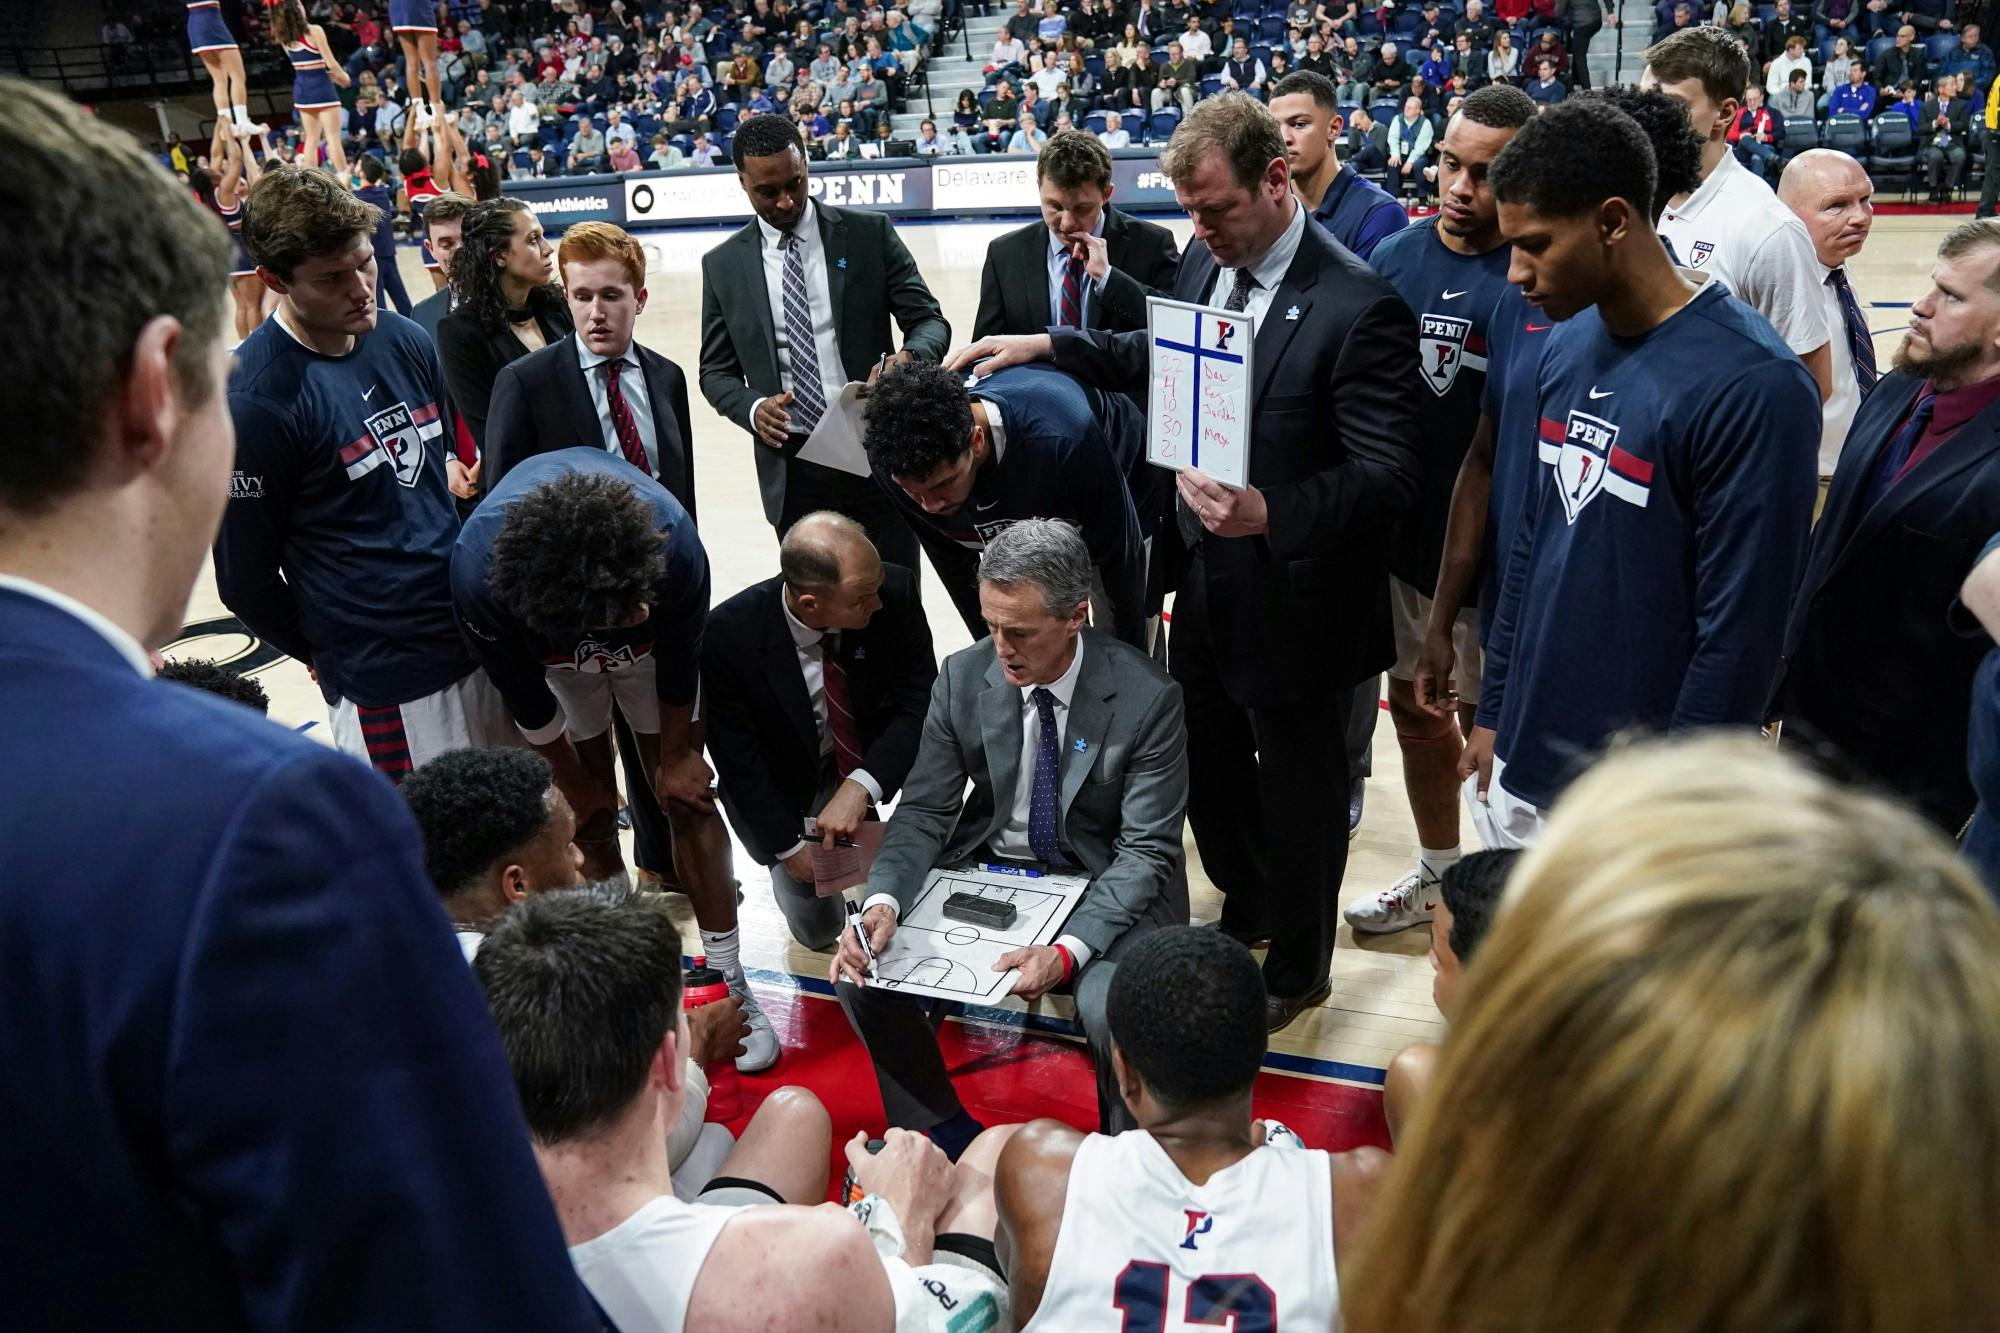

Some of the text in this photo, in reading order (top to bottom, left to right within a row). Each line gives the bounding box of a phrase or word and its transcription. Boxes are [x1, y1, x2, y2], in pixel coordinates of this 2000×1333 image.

[938, 168, 1028, 188] Delaware
[1216, 320, 1235, 350] P
[1423, 320, 1464, 339] PENN
[1433, 344, 1456, 378] P
[1164, 374, 1176, 398] 4
[1162, 414, 1182, 437] 30
[1162, 439, 1177, 460] 21
[232, 476, 264, 491] IVY
[1179, 1208, 1213, 1250] P
